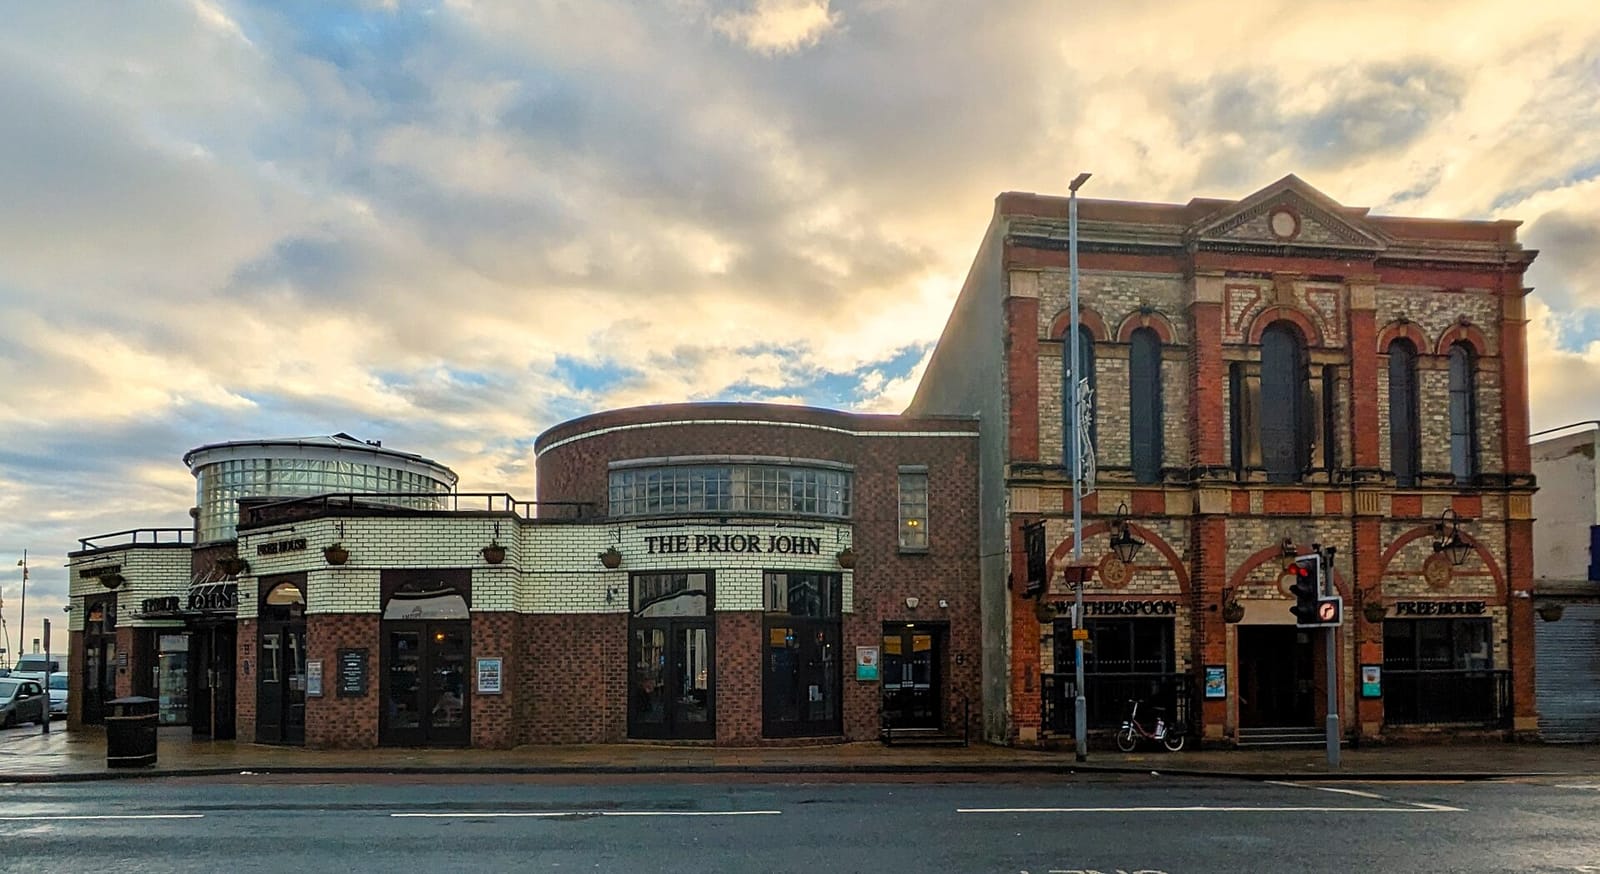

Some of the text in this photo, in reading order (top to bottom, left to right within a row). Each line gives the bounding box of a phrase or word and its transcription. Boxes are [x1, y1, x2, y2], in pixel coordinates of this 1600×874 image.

[644, 534, 821, 555] THE PRIOR JOHN
[1053, 600, 1177, 615] WTHERSPOON
[1396, 600, 1487, 615] FREE HOUSE
